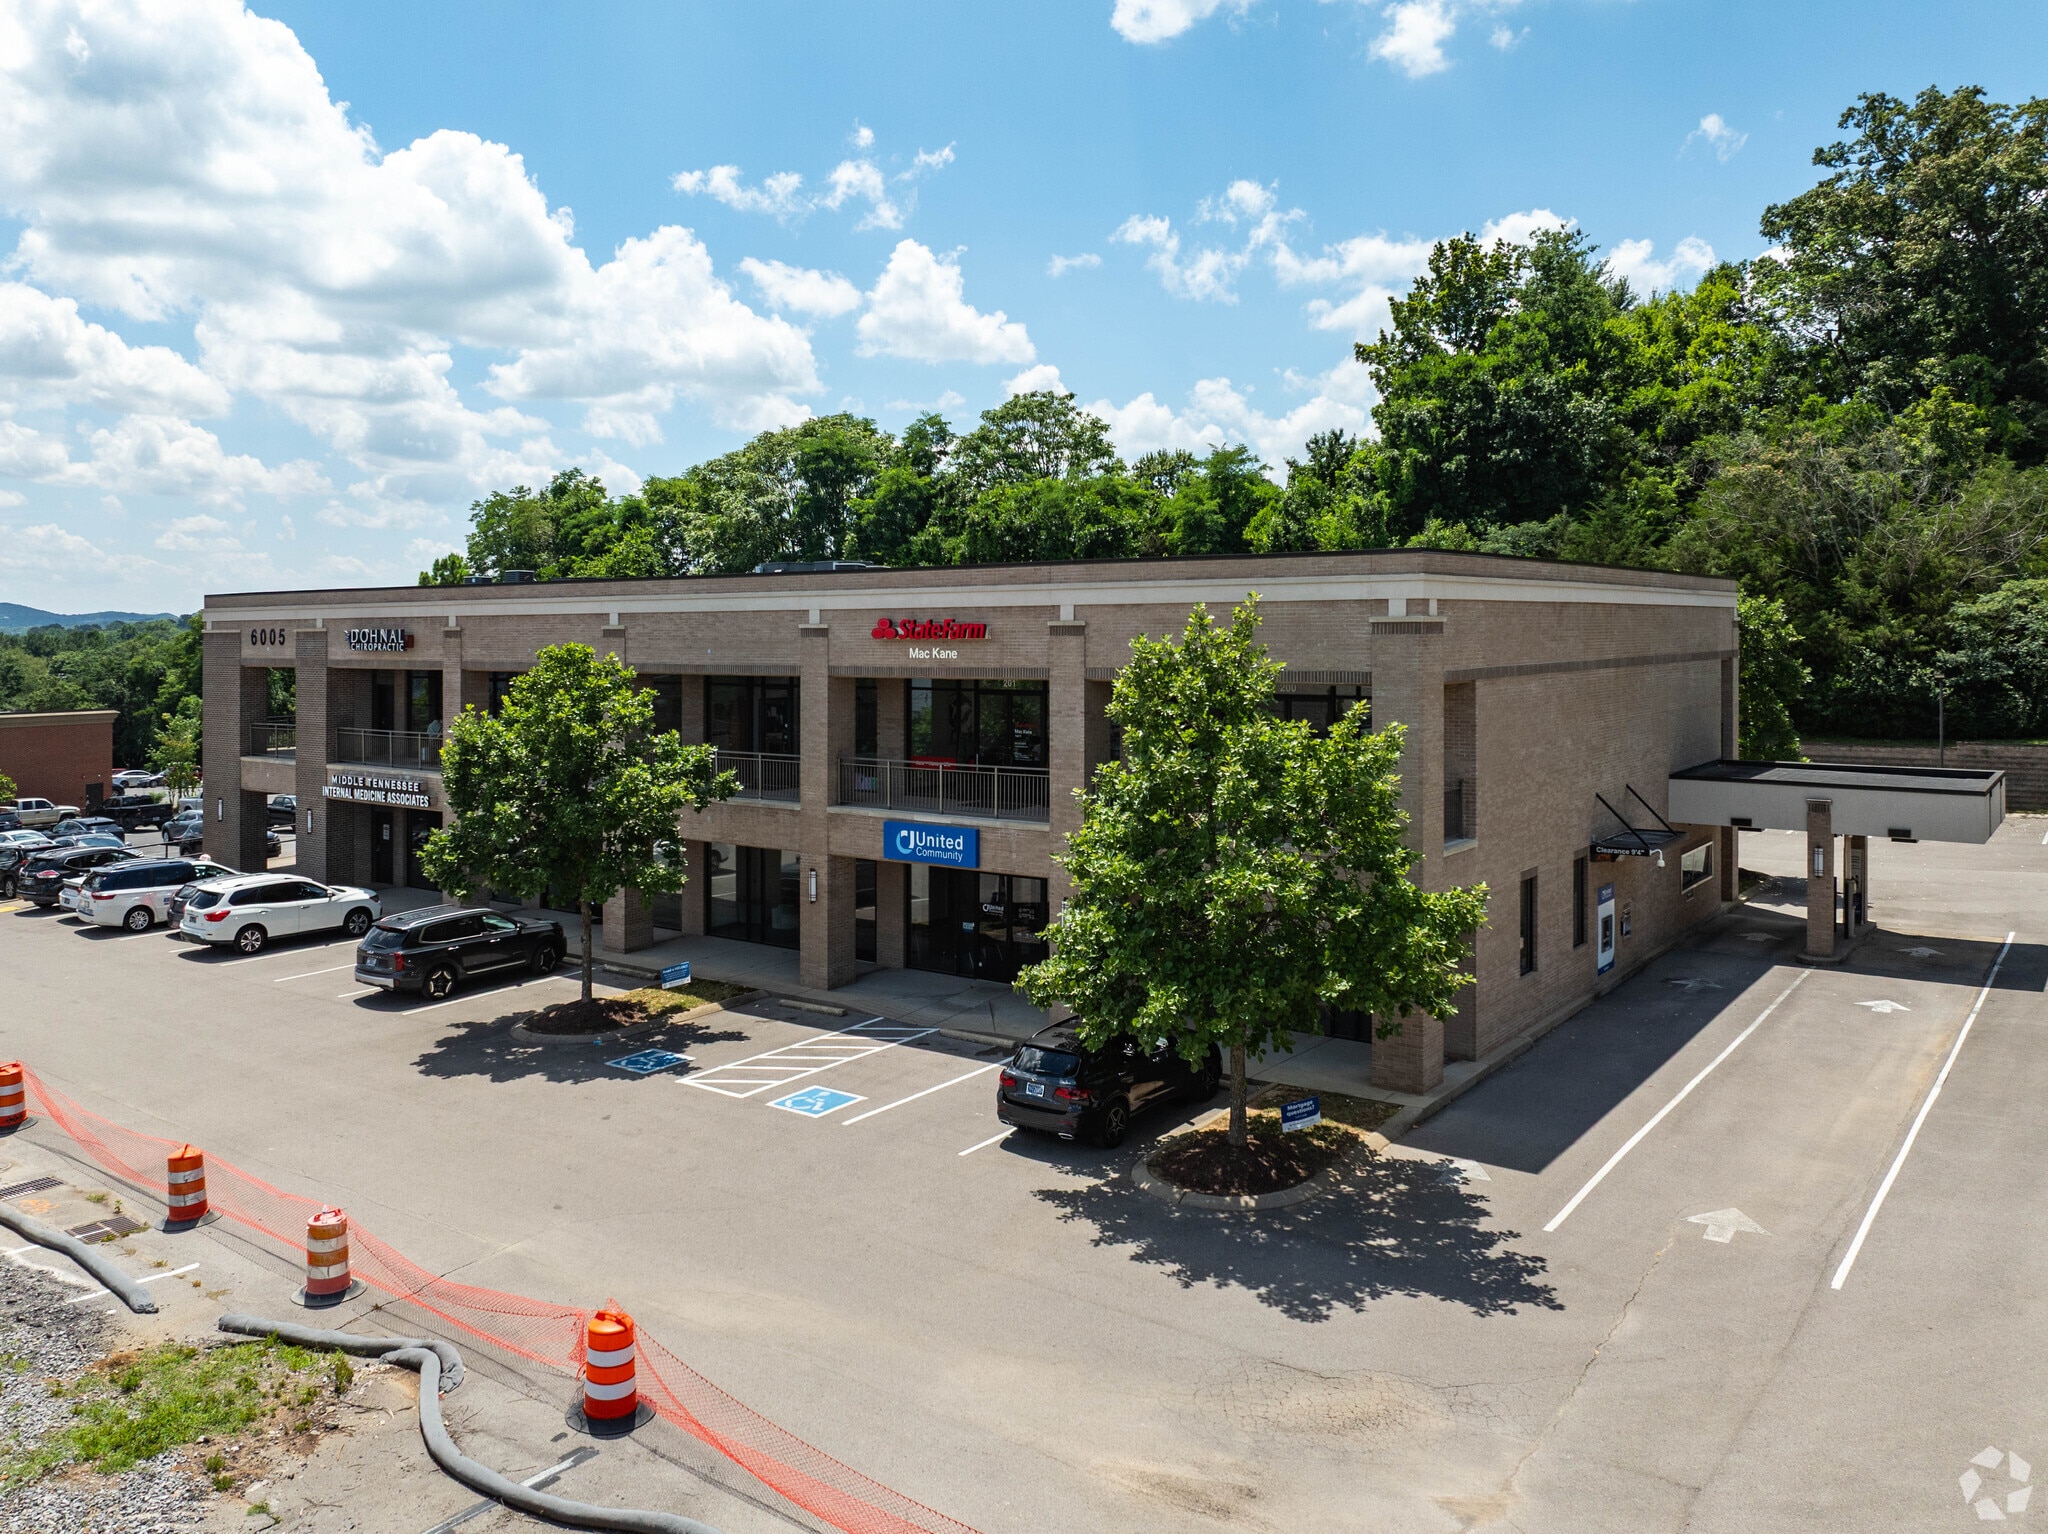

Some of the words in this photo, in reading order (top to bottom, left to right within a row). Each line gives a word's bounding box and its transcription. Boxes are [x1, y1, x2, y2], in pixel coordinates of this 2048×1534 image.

[250, 628, 286, 646] 6005
[350, 629, 404, 643] DOHNAL
[351, 643, 405, 652] CHIROPRACTIC
[909, 647, 930, 659] Mac
[932, 647, 958, 659] Kane
[1003, 679, 1016, 688] 201
[1280, 684, 1297, 693] 200
[331, 775, 364, 787] MIDDLE
[367, 778, 419, 792] TENNESSEE
[322, 786, 353, 799] INTERNAL
[353, 789, 386, 803] MEDICINE
[387, 793, 430, 808] ASSOCIATES
[916, 831, 964, 851] United
[916, 847, 964, 863] Community
[1595, 846, 1630, 855] Clearance
[1287, 1100, 1313, 1111] Mortgage
